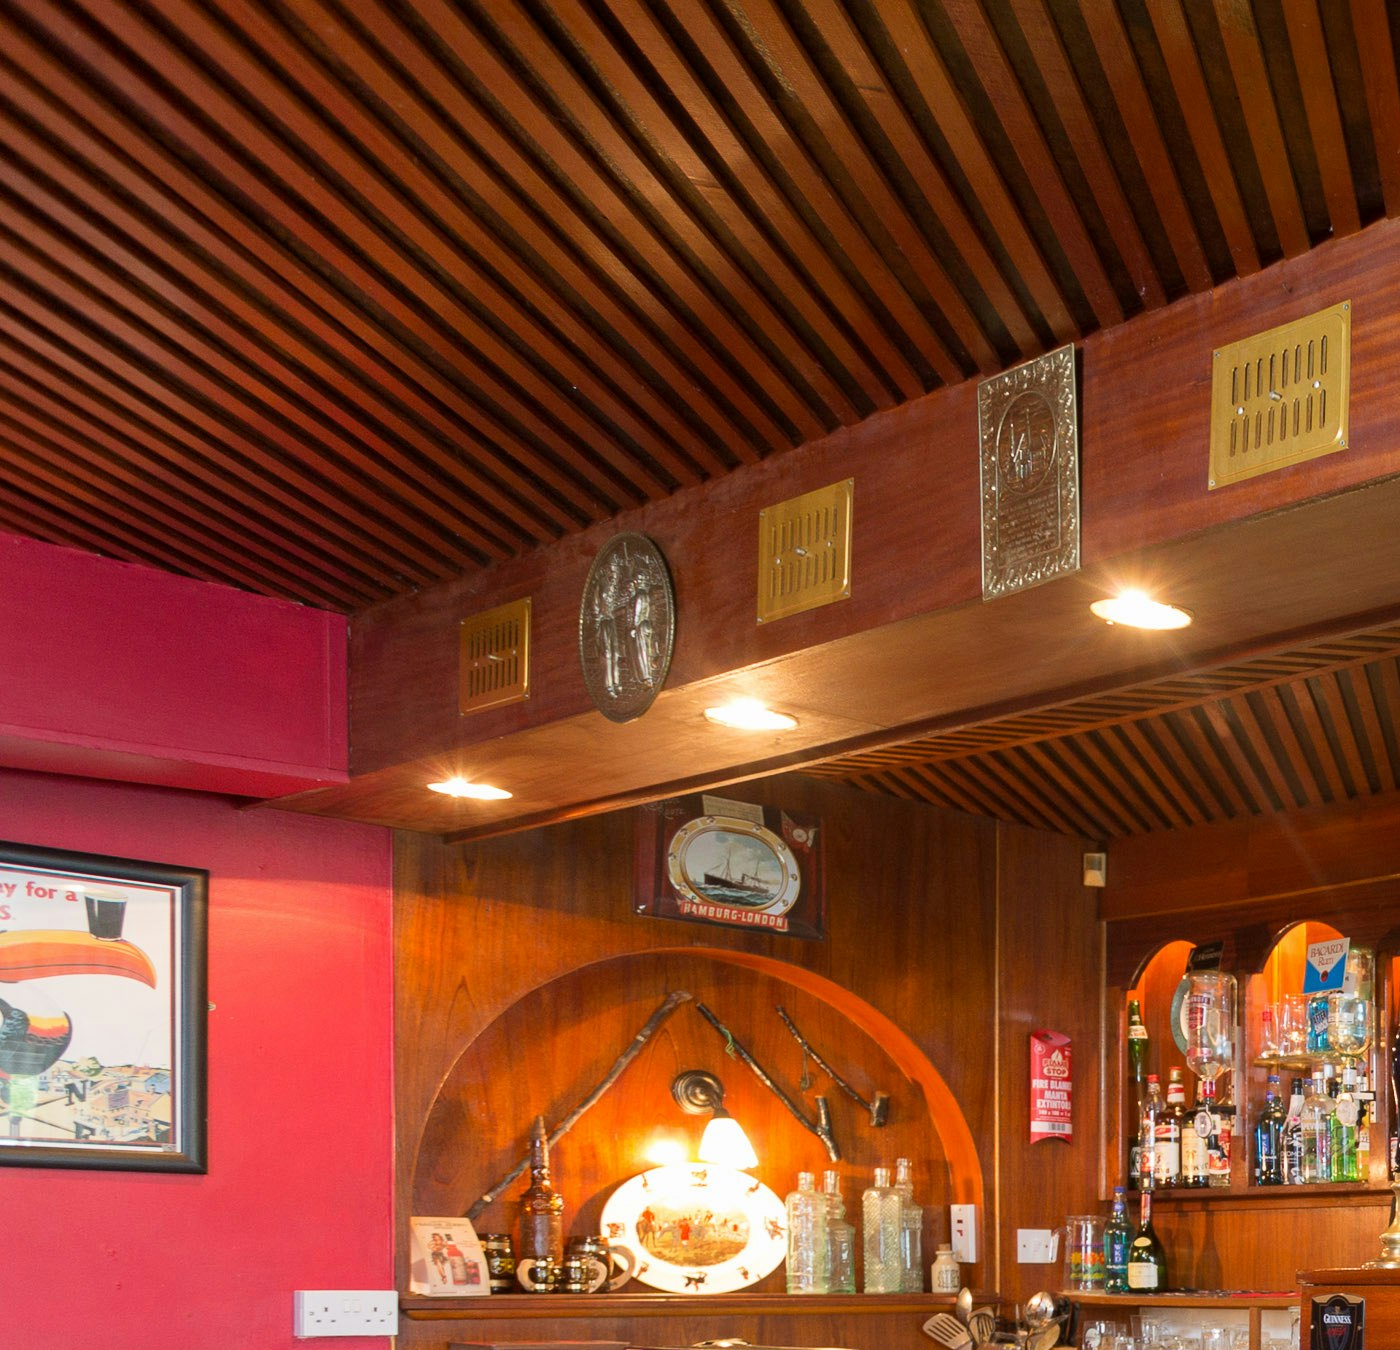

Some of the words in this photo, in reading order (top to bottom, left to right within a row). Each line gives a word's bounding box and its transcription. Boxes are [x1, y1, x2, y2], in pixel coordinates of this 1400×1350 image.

[26, 881, 57, 901] for
[65, 888, 78, 902] a
[683, 902, 783, 927] HAMBURG-LONDON
[1310, 943, 1344, 958] BACARDI
[1318, 955, 1334, 967] Rum
[1046, 1067, 1067, 1075] STOP
[1323, 1314, 1352, 1324] GUINNESS
